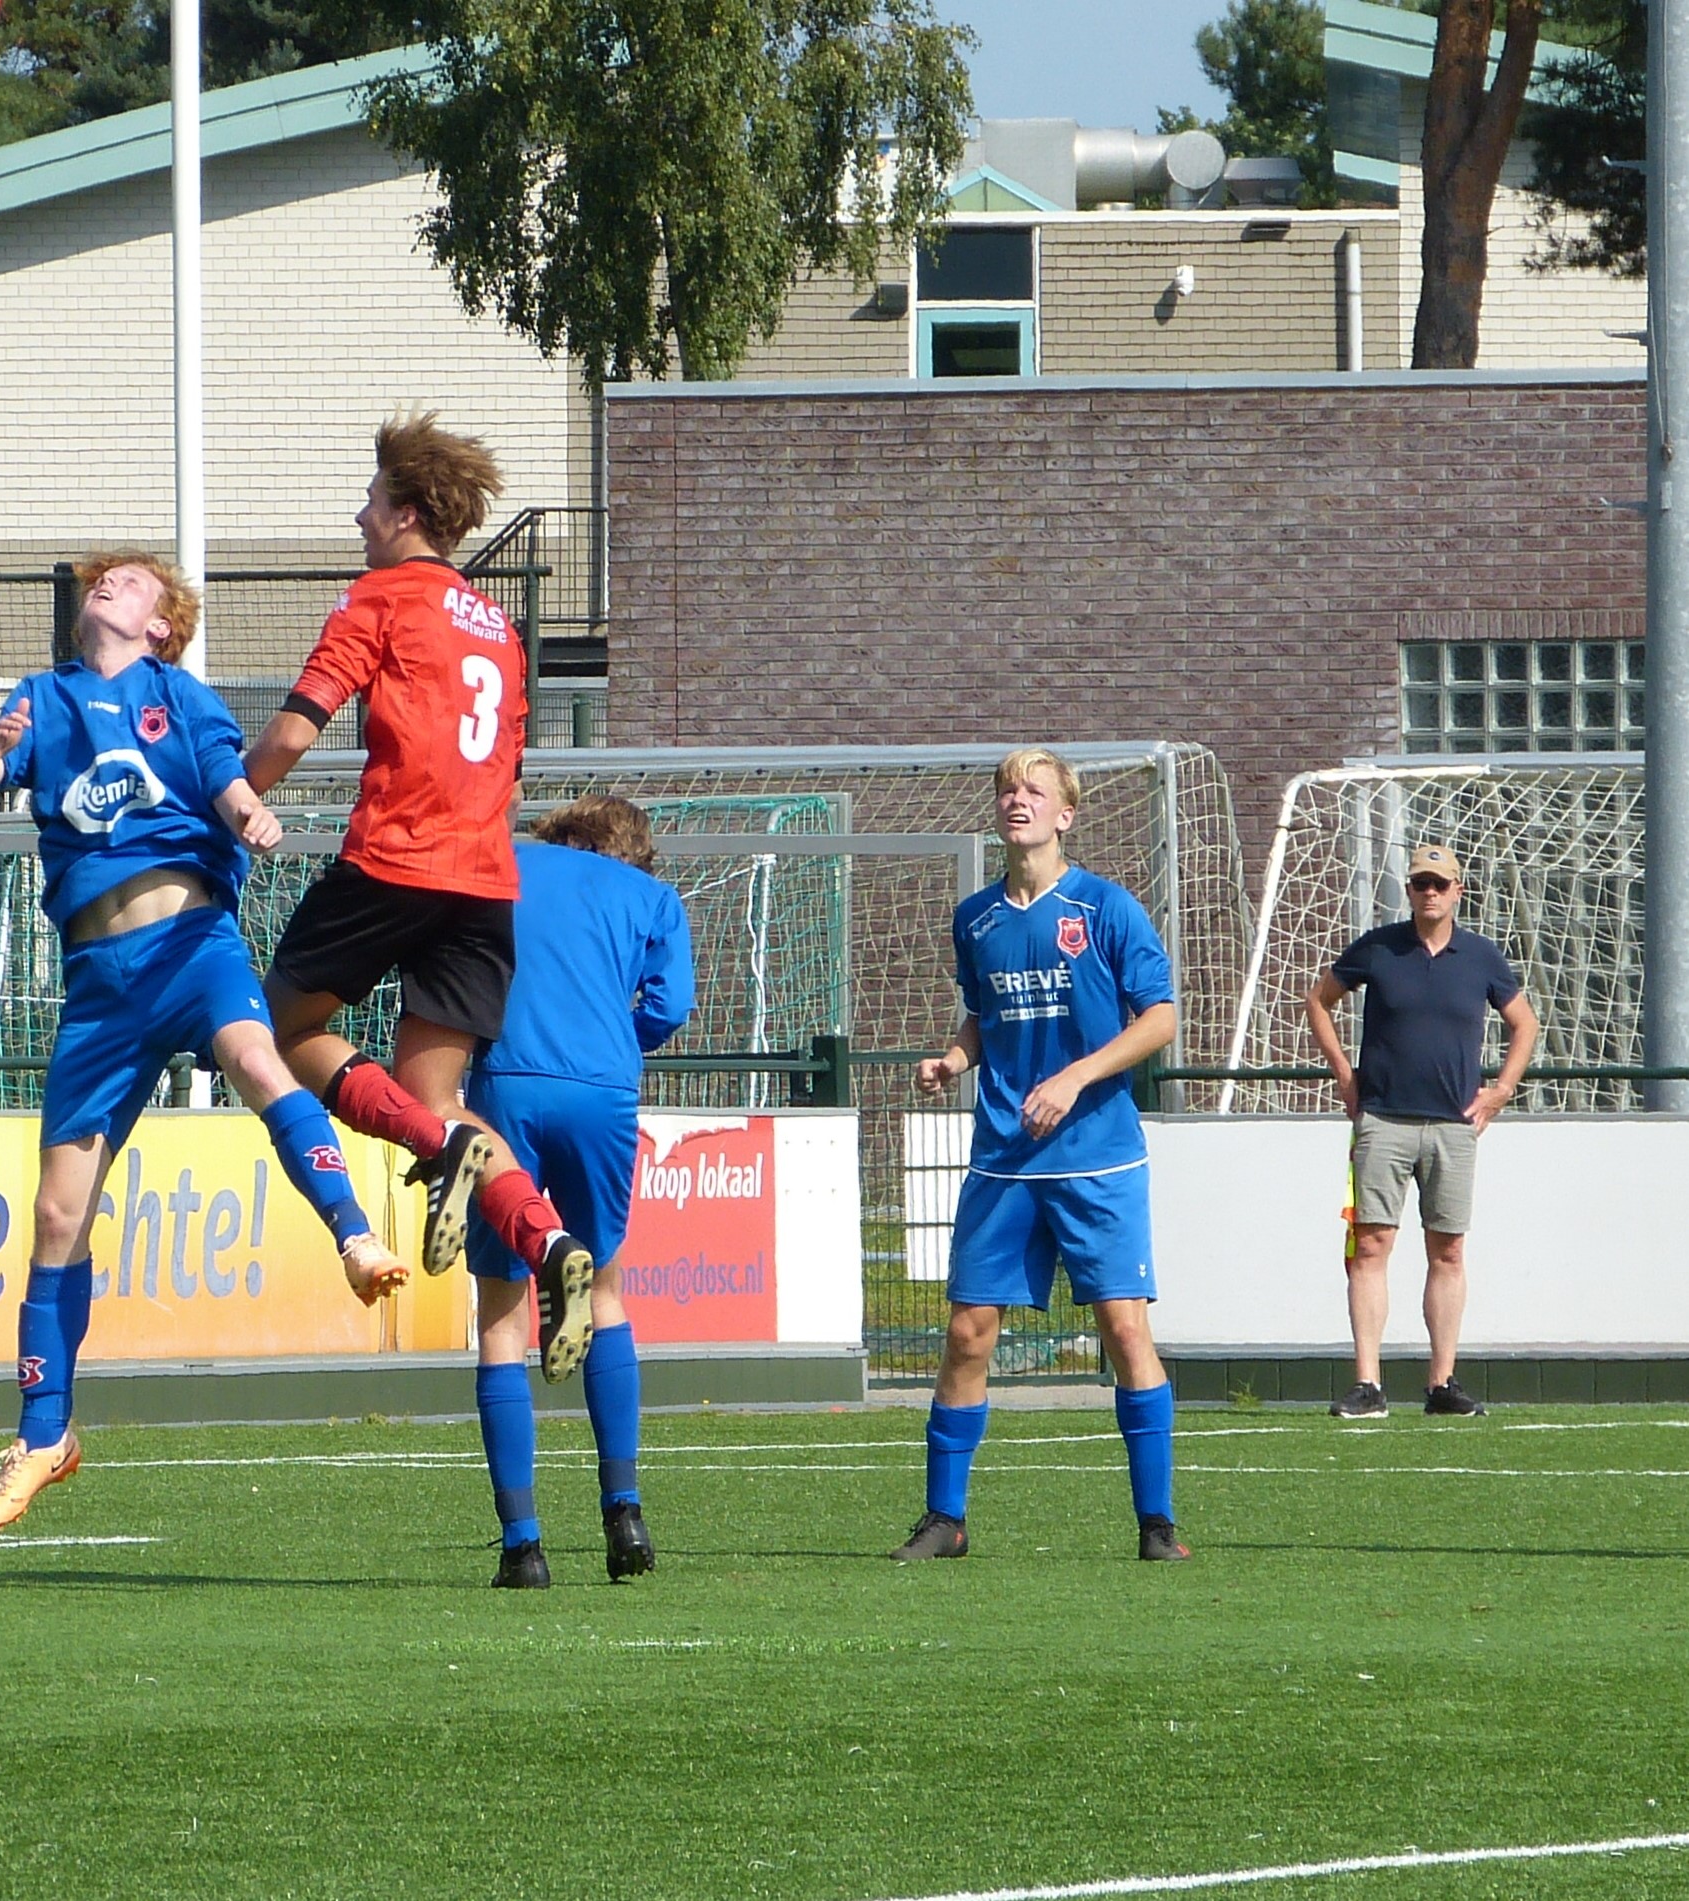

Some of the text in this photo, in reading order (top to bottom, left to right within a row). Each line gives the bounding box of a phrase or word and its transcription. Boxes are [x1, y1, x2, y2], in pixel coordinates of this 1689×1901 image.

[443, 587, 506, 629] AFAS
[451, 614, 507, 644] software
[459, 655, 503, 763] 3
[76, 774, 151, 813] Remia
[989, 961, 1072, 994] BREVÉ
[640, 1153, 764, 1210] koop lokaal
[88, 1147, 268, 1298] chte!
